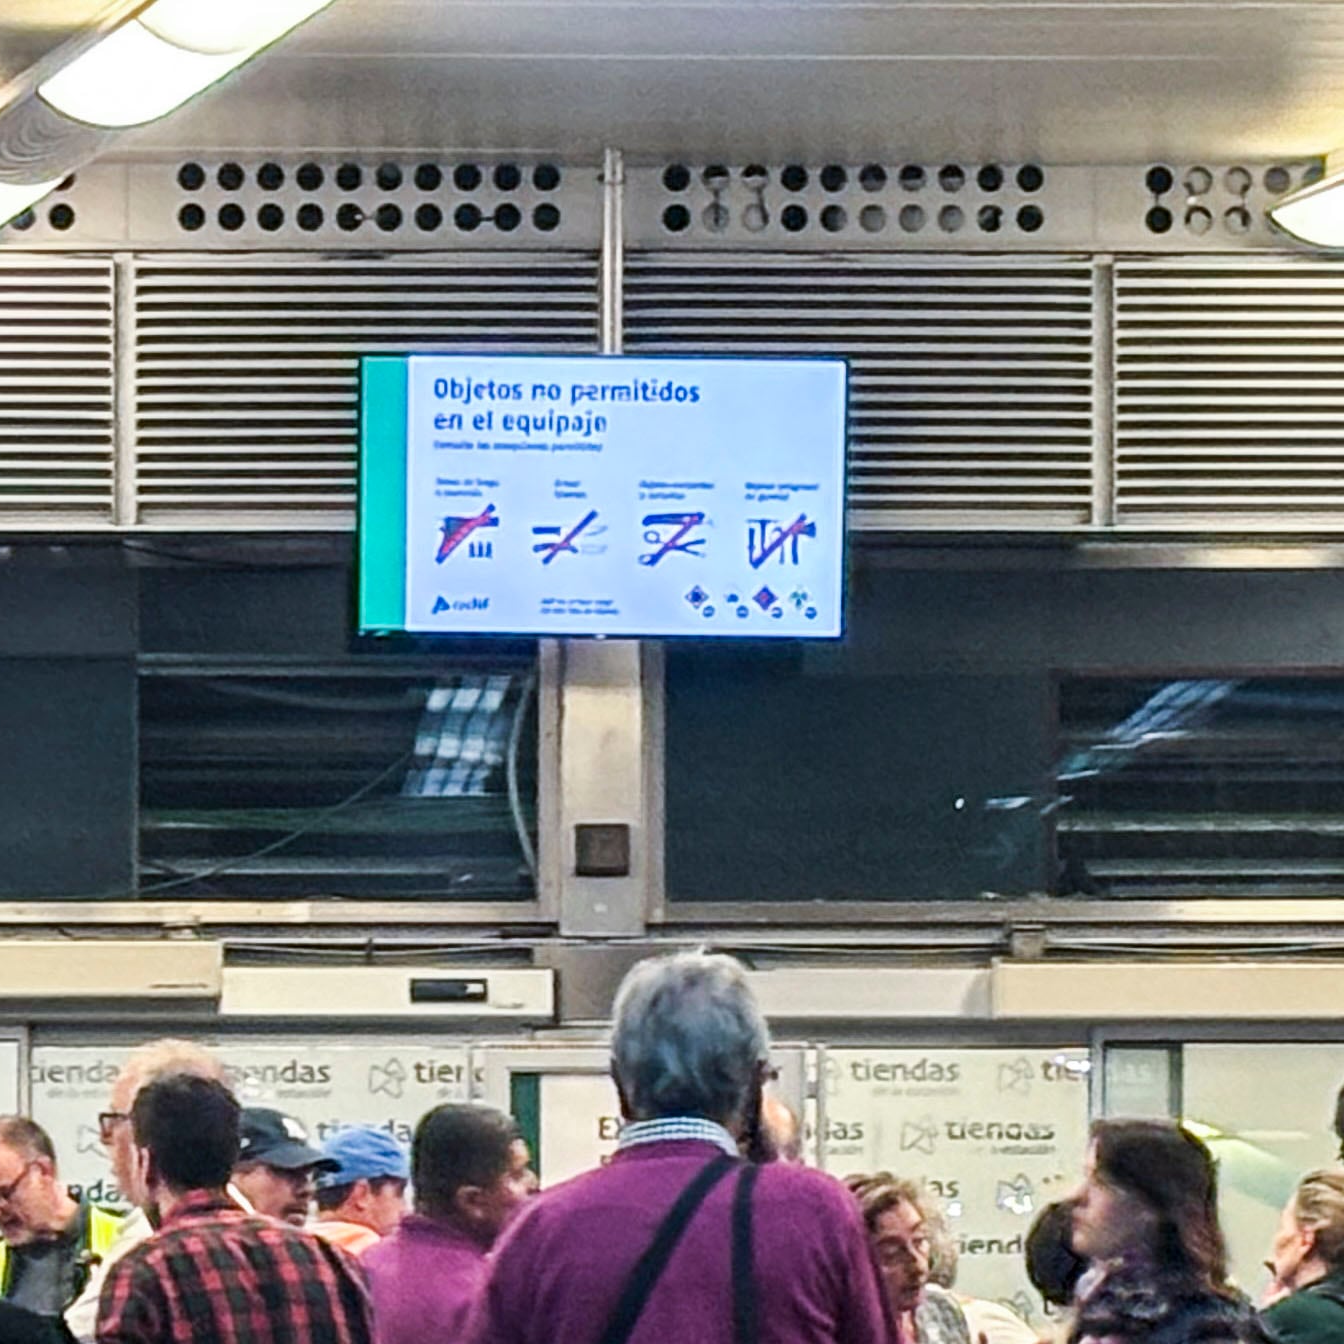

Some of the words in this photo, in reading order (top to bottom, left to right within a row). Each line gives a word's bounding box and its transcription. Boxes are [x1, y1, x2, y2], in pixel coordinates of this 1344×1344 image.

[433, 376, 523, 405] Objetos
[531, 382, 562, 401] no
[570, 378, 701, 406] permitidos
[434, 412, 463, 431] en
[472, 410, 493, 431] el
[502, 408, 607, 437] equipaje
[850, 1057, 960, 1083] tiendas
